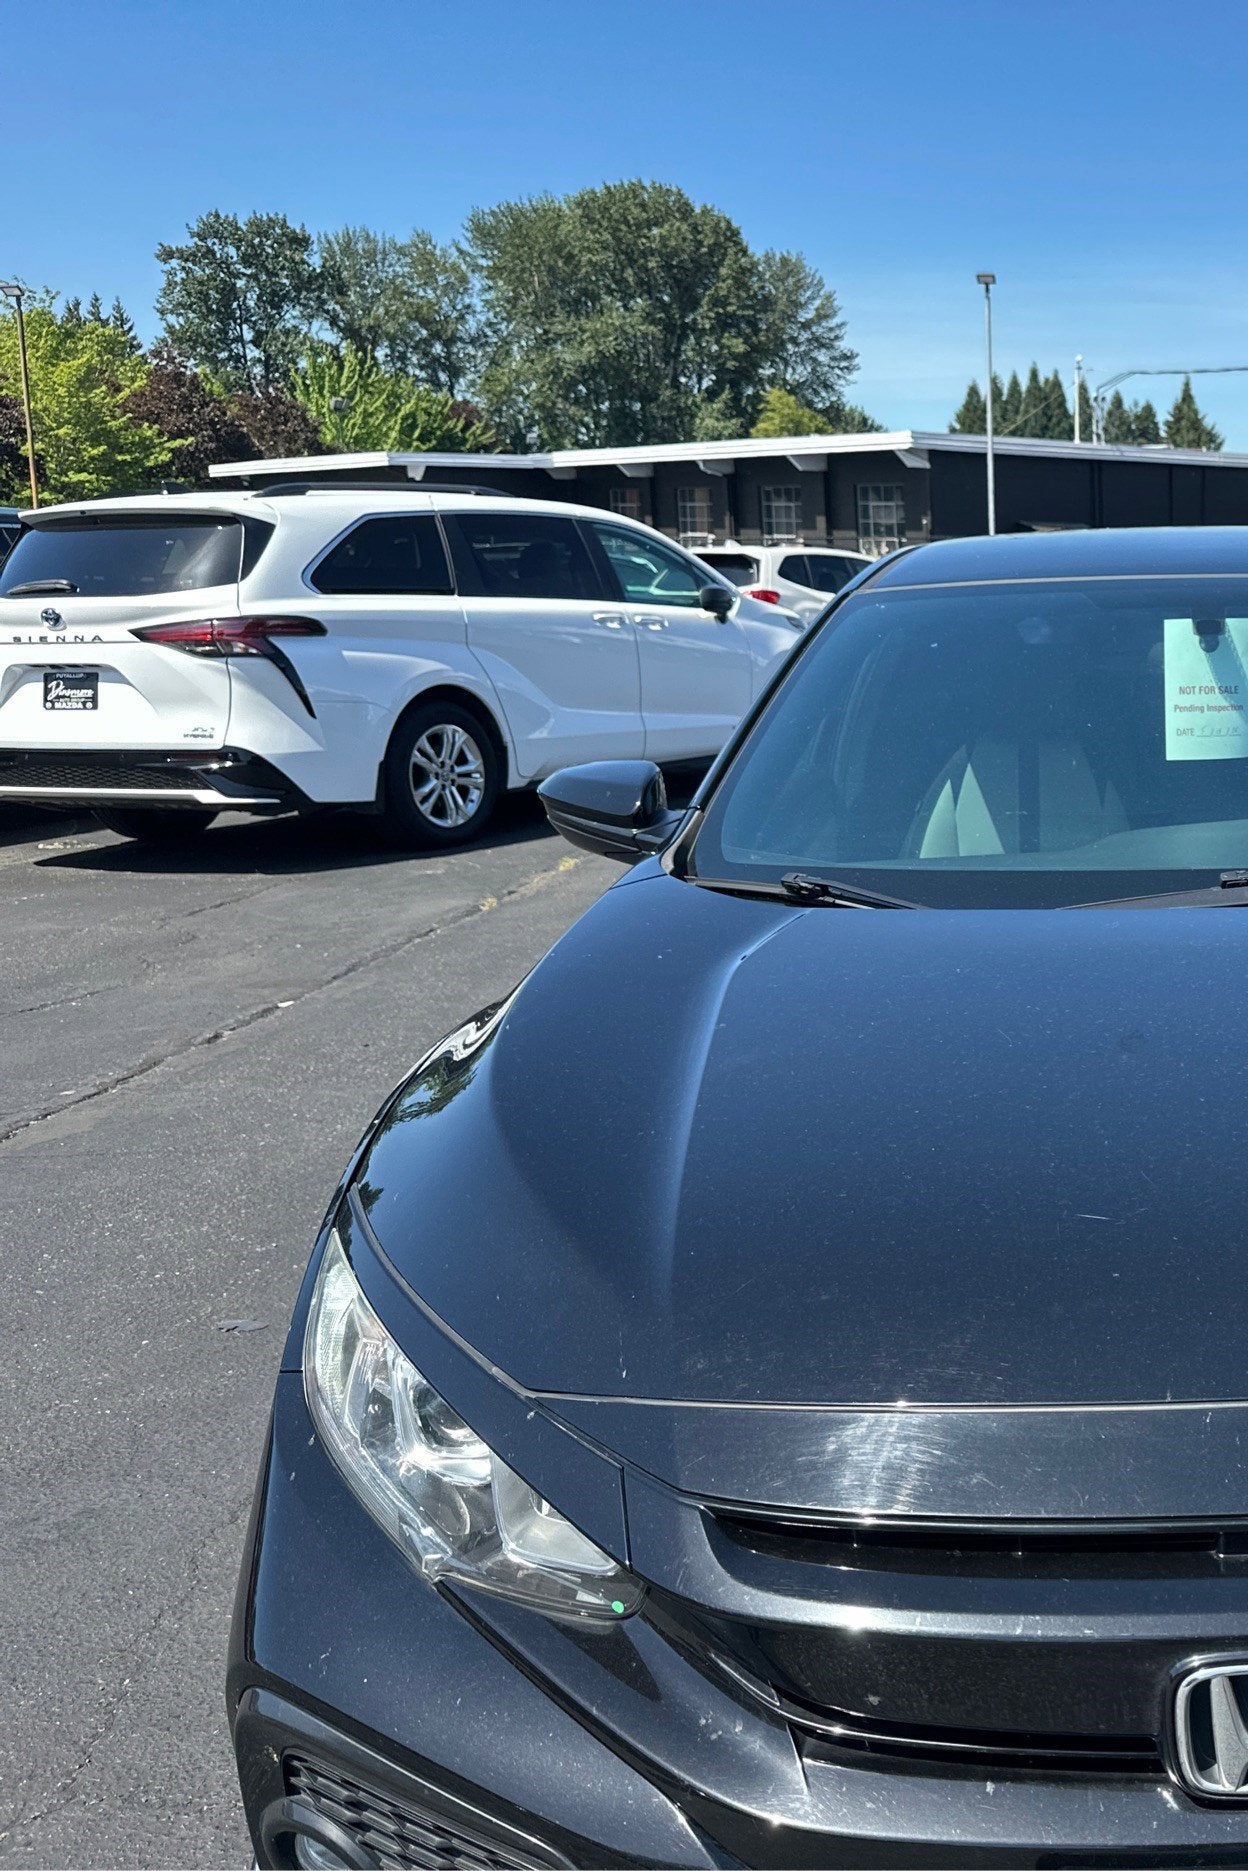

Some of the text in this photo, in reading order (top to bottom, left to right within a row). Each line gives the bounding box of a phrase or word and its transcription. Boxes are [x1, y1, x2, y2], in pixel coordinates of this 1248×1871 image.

[12, 634, 105, 643] SIENNA
[1179, 685, 1240, 695] NOT FOR SALE
[54, 701, 84, 709] MAZDA
[1174, 704, 1244, 714] Pending Inspection
[1176, 728, 1195, 737] DATE
